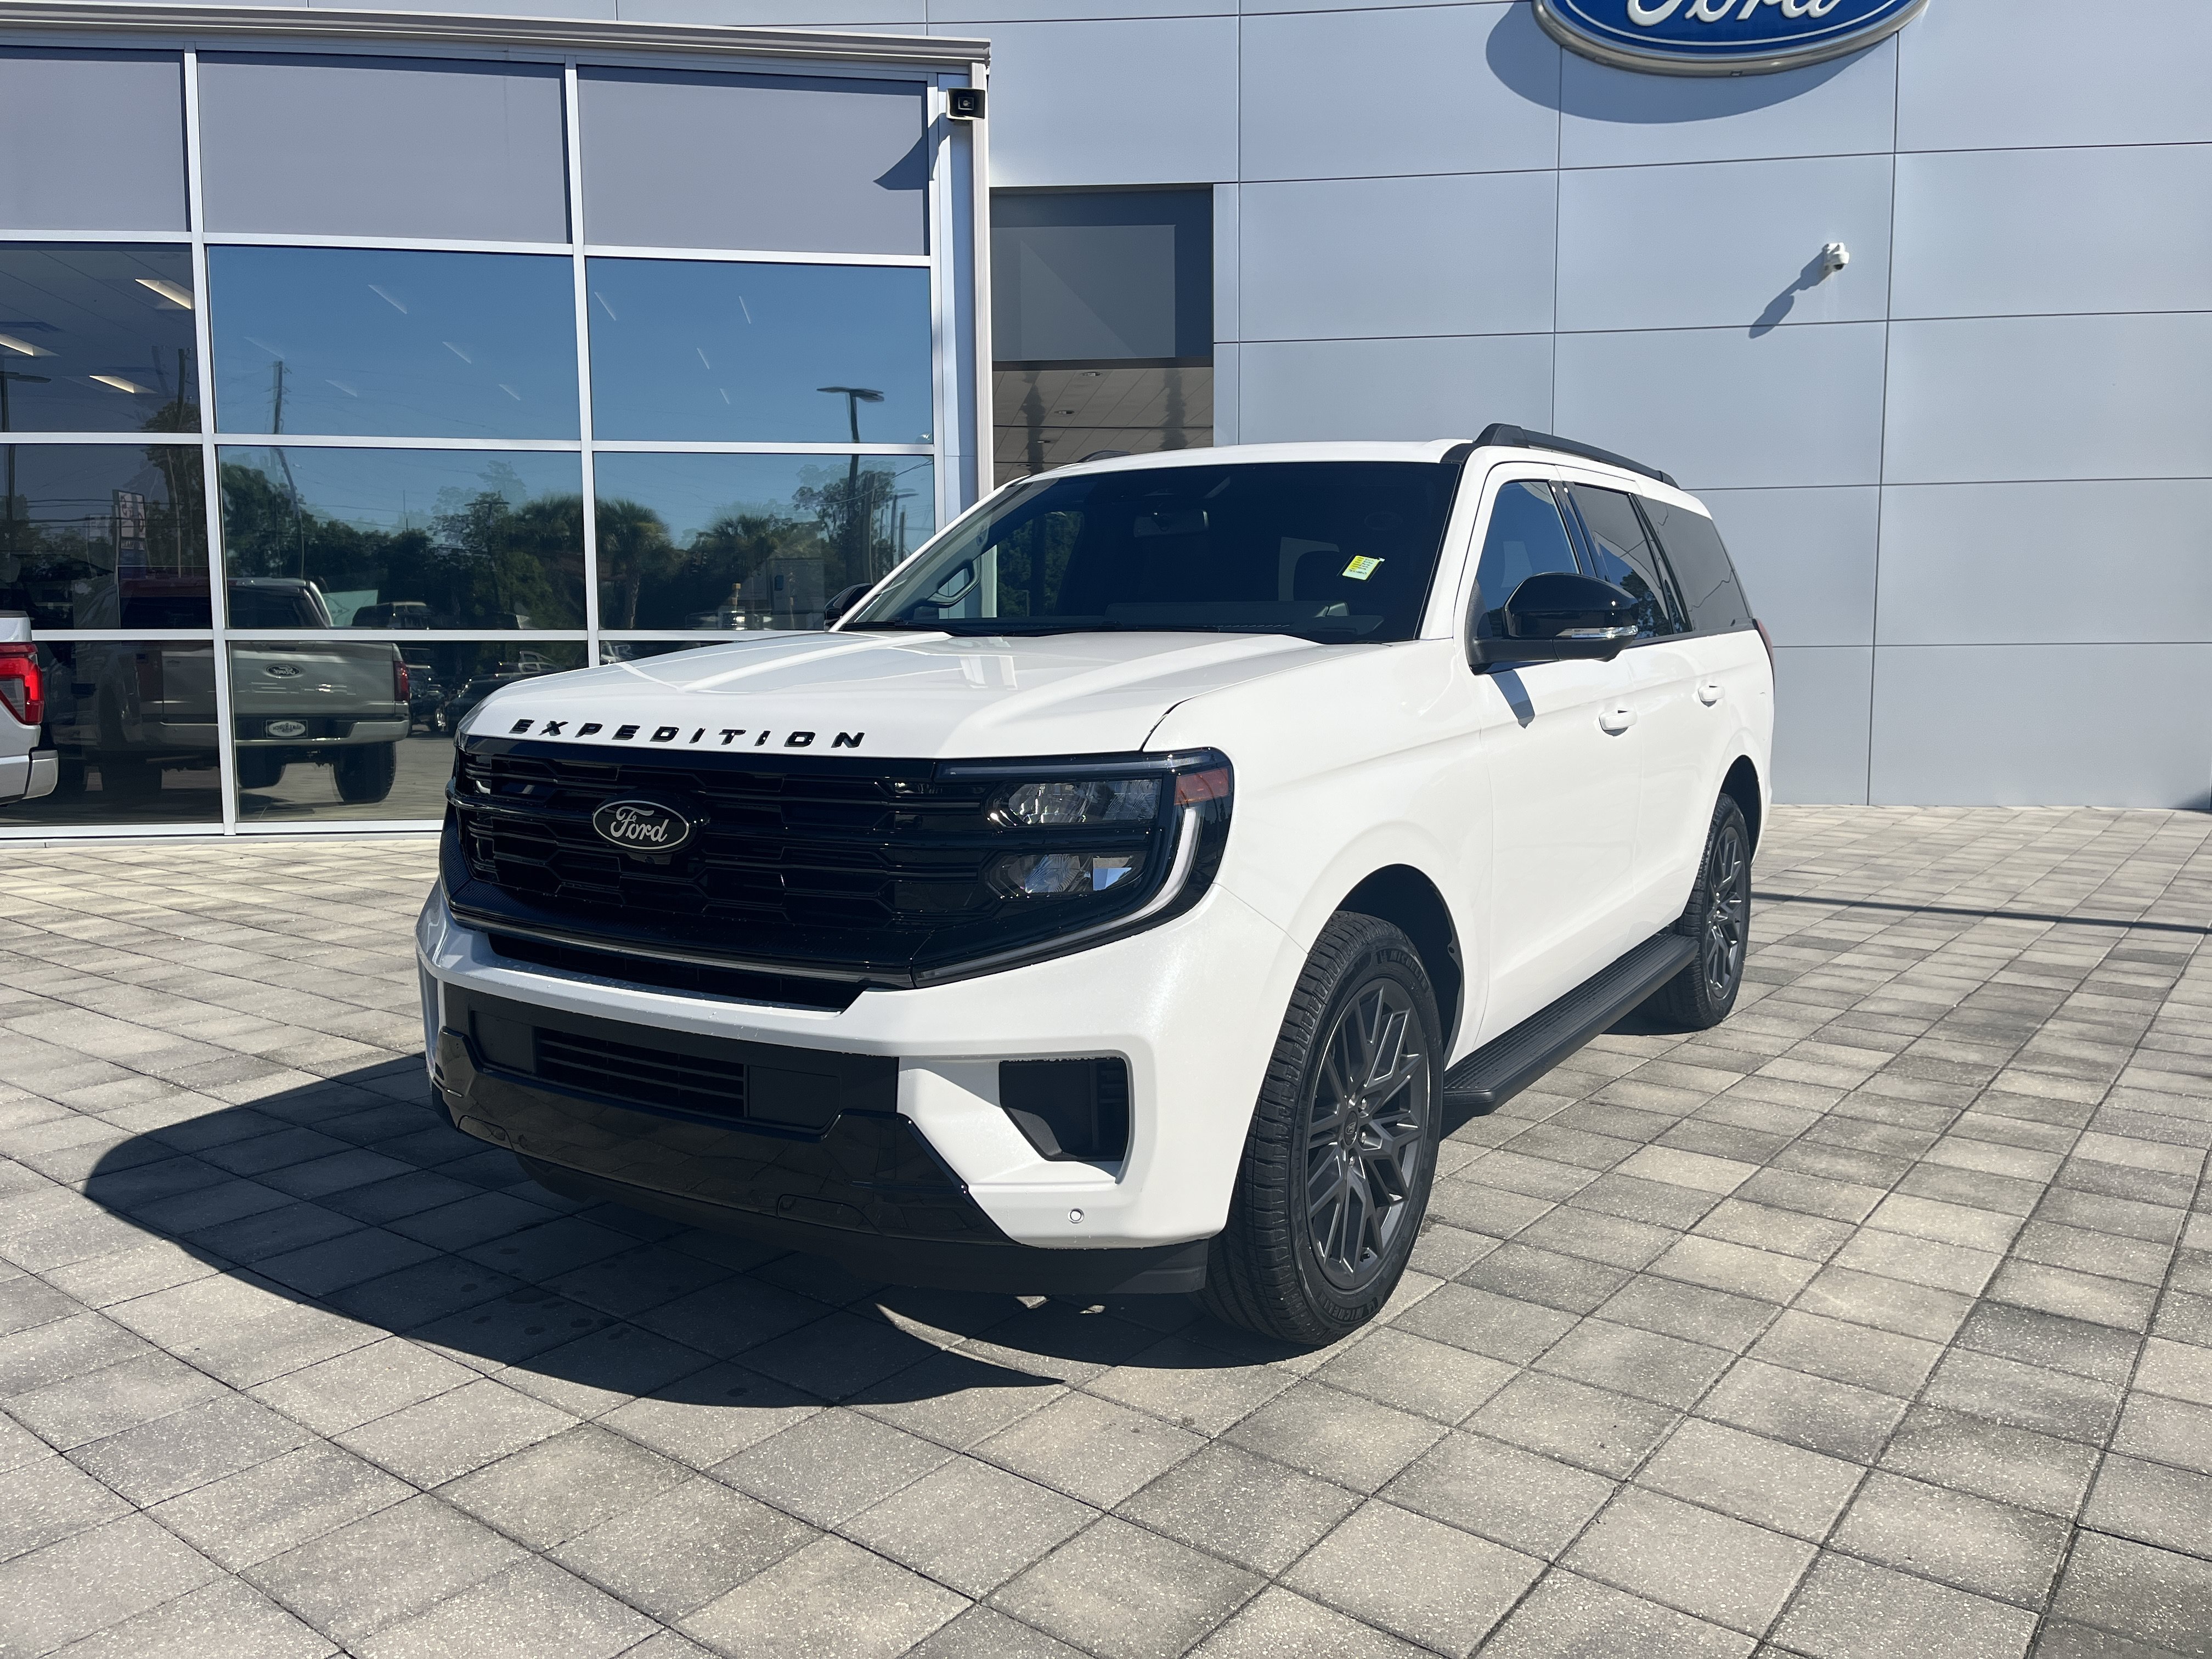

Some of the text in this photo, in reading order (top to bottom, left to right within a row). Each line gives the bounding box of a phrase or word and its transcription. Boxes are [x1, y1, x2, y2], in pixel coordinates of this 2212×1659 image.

[510, 719, 865, 748] EXPEDITION
[610, 805, 670, 843] Ford
[1390, 950, 1429, 989] MICHELIN
